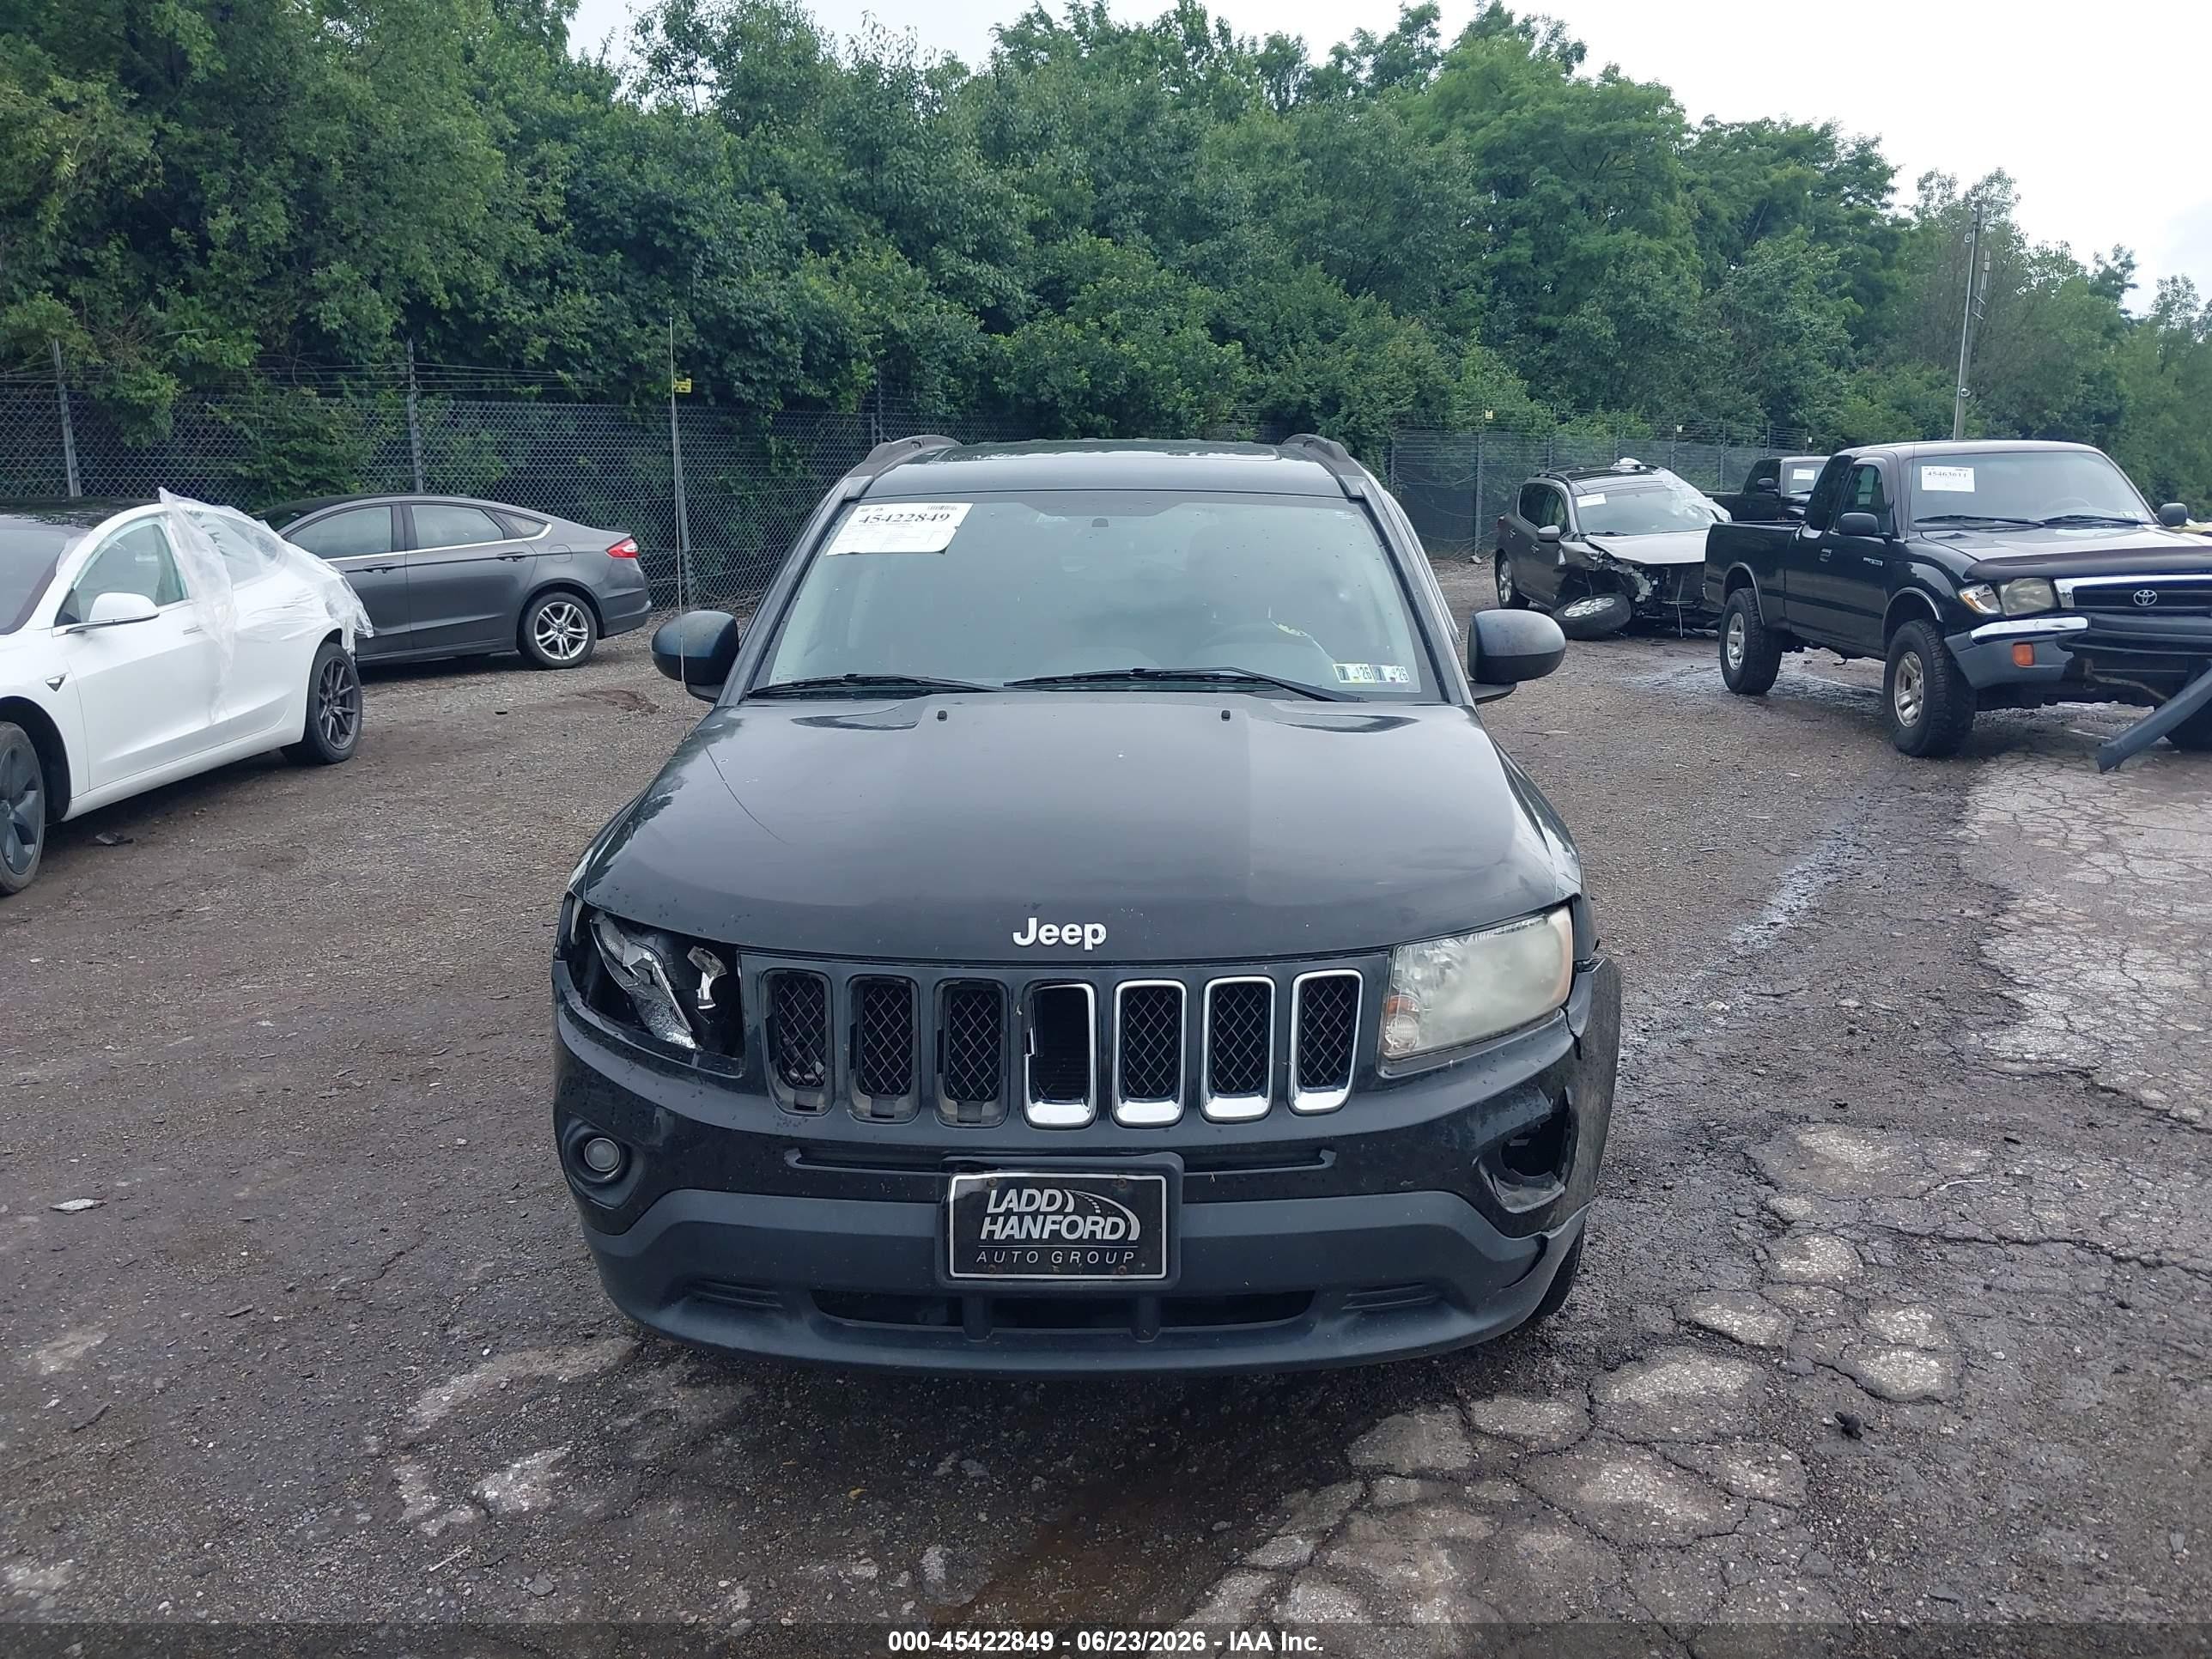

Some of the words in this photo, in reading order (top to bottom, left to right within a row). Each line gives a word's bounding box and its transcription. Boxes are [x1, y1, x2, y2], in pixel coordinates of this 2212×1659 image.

[859, 513, 951, 524] 45422849
[1012, 917, 1107, 951] Jeep
[987, 1188, 1063, 1214] LADD
[980, 1215, 1126, 1240] HANFORD
[975, 1250, 1039, 1264] AUTO
[1051, 1250, 1134, 1264] GROUP
